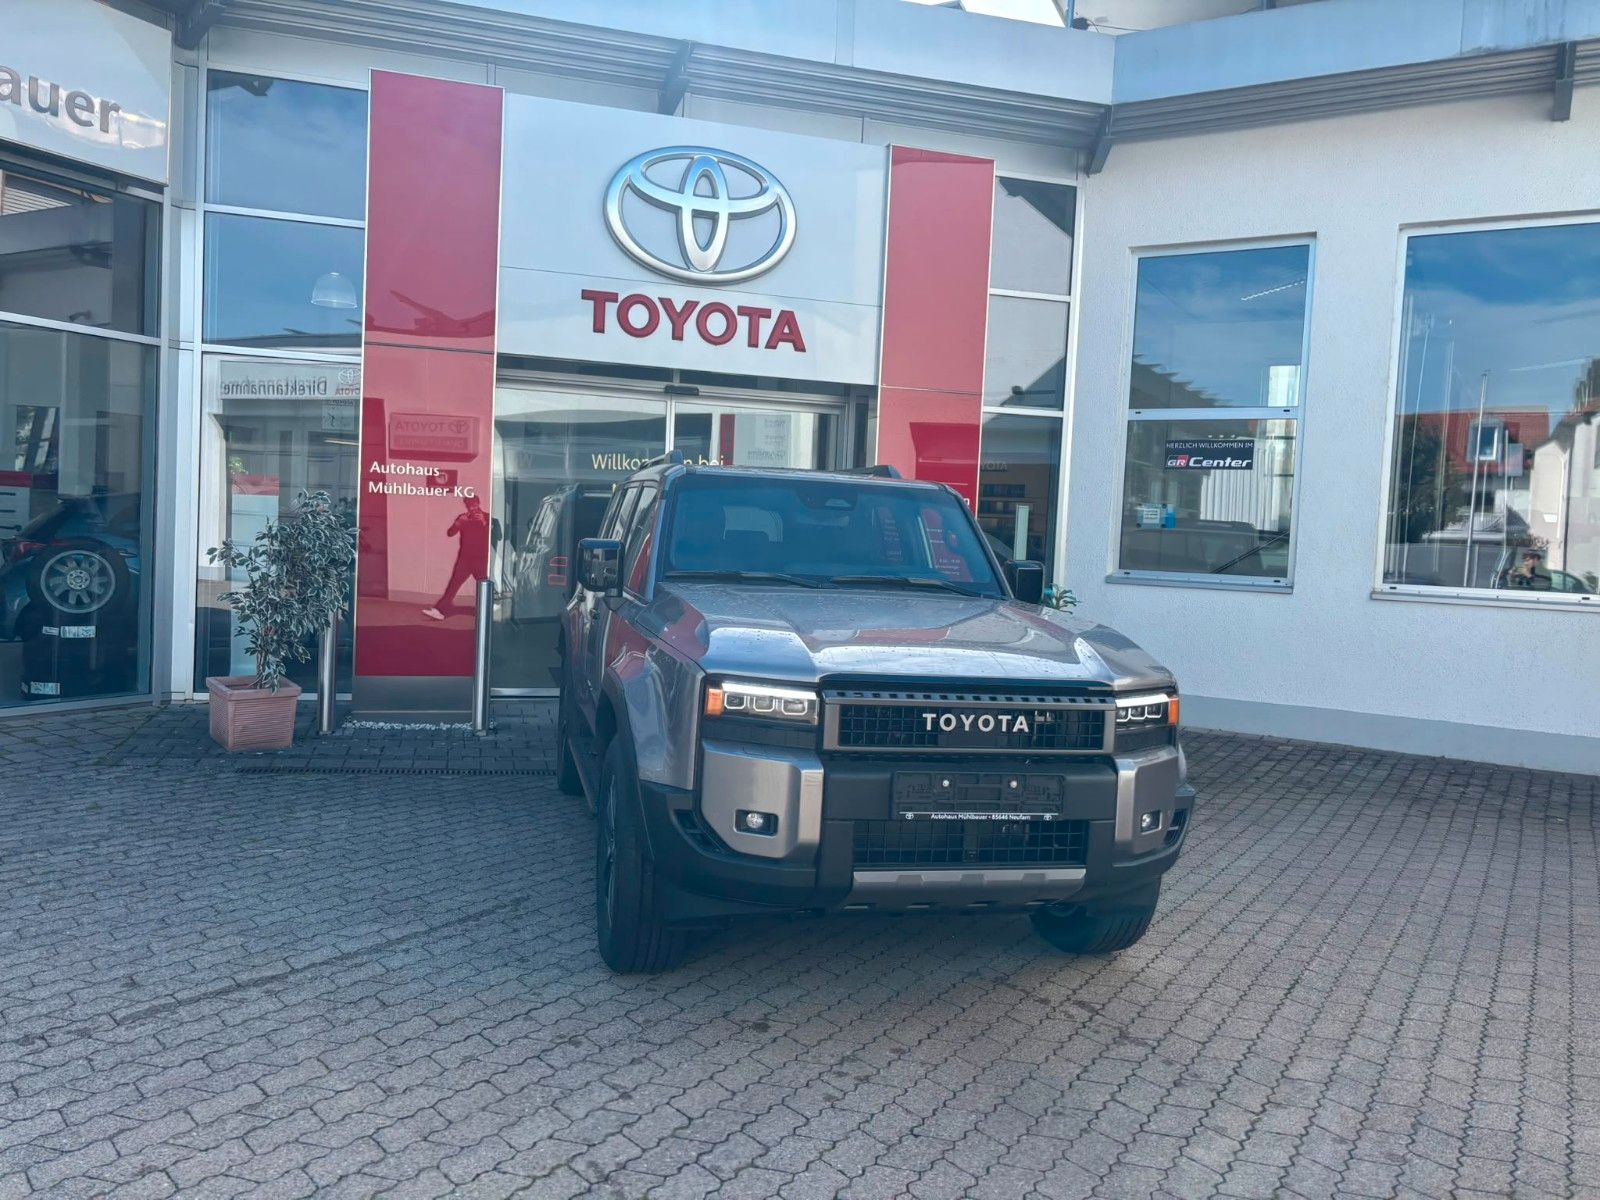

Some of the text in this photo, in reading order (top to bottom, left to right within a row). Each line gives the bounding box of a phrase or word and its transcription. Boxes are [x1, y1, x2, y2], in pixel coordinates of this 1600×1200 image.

[581, 289, 807, 353] TOYOTA
[370, 461, 440, 477] Autohaus
[1189, 457, 1252, 467] Center
[368, 481, 475, 498] Mühlbauer KG
[922, 713, 1029, 733] TOYOTA
